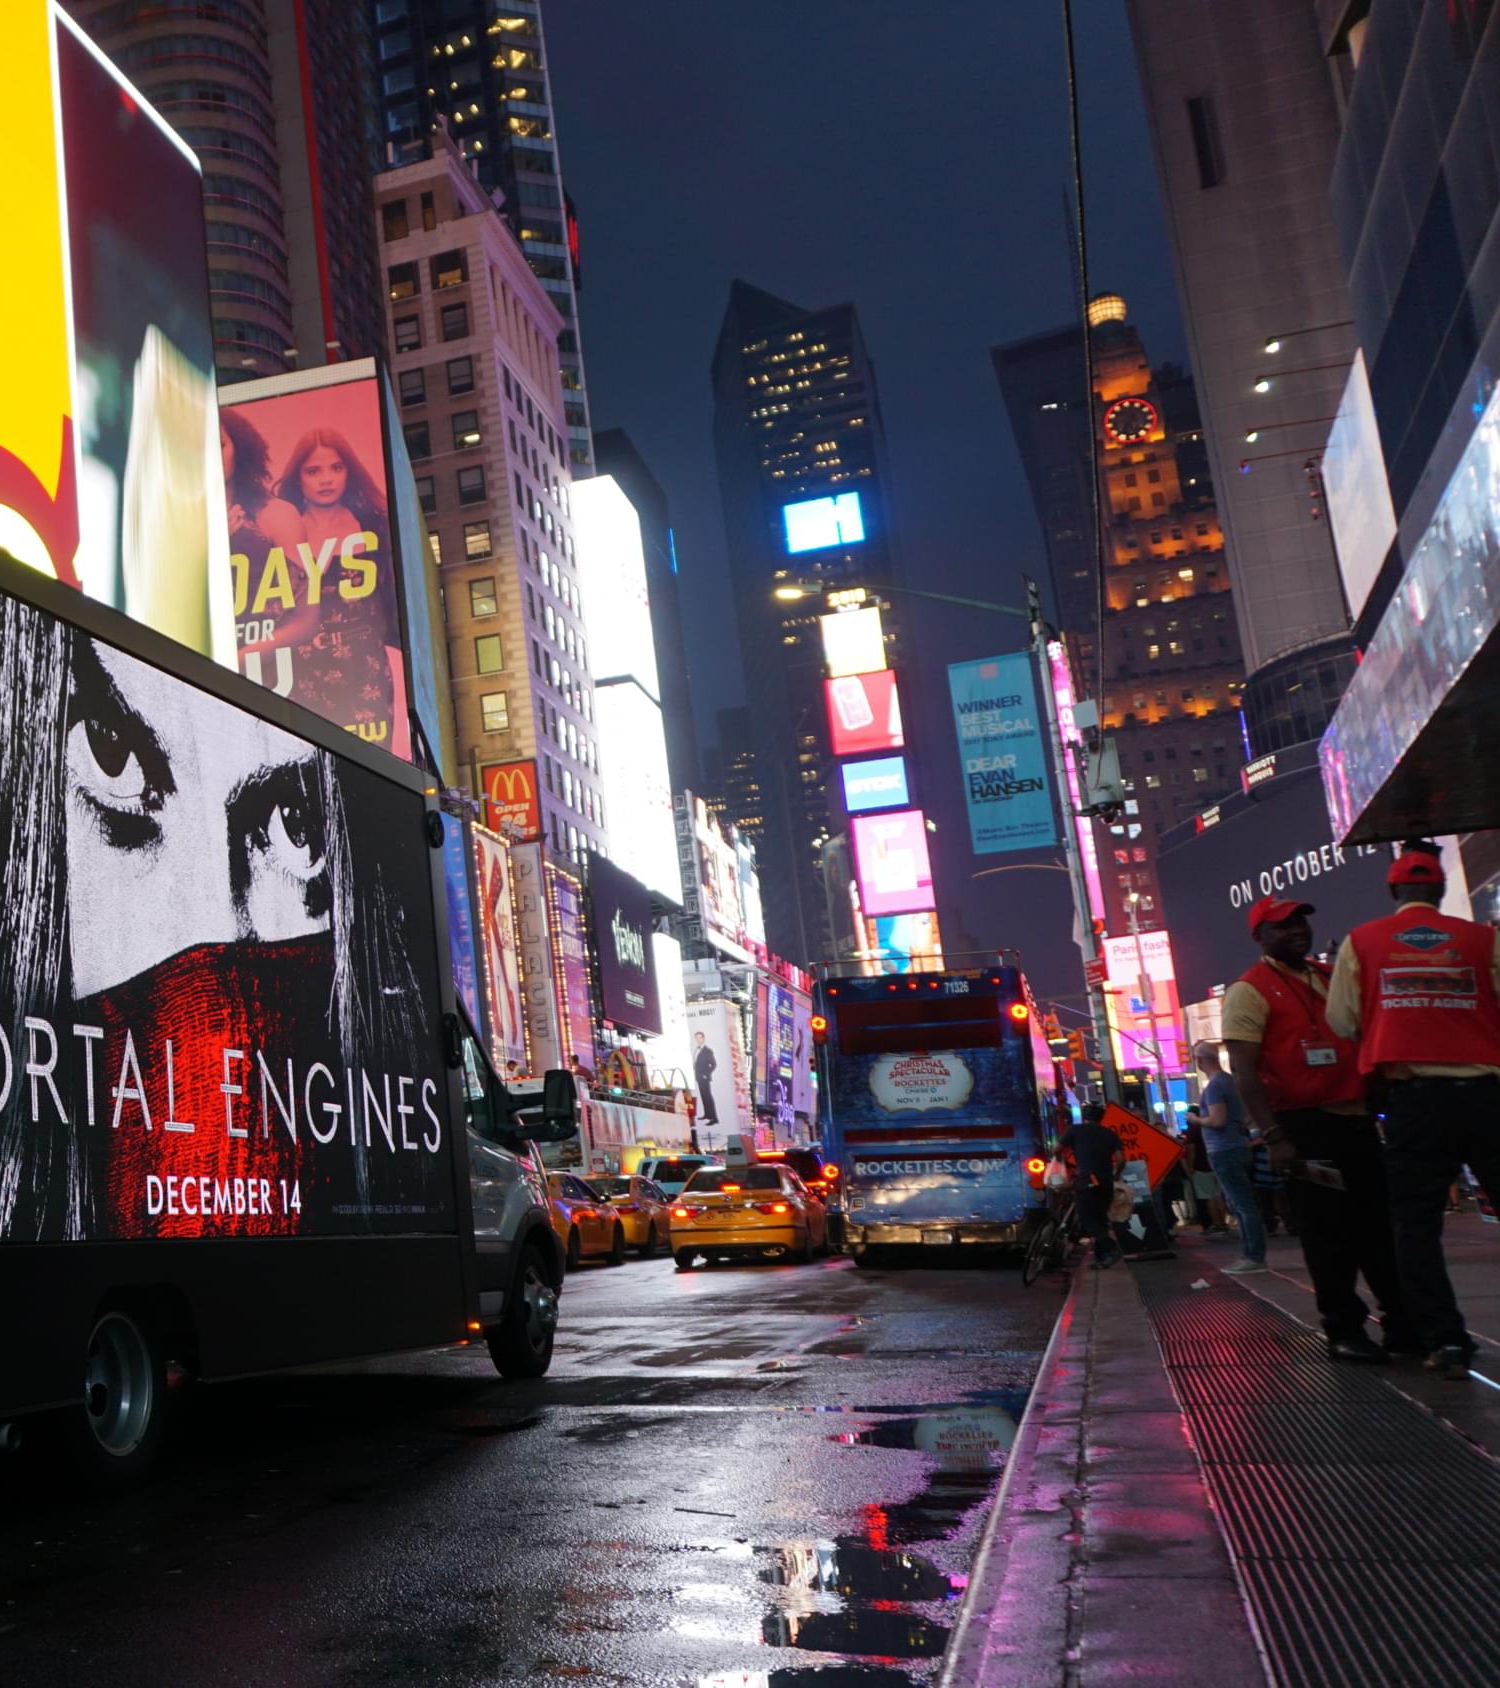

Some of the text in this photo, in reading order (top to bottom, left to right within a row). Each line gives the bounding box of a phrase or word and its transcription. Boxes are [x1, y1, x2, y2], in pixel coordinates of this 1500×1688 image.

[236, 619, 275, 645] FOR
[958, 694, 1022, 714] WINNER
[960, 710, 1001, 726] BEST
[962, 718, 1034, 738] MUSICAL
[966, 754, 1017, 773] DEAR
[968, 767, 1015, 786] EVAN
[970, 776, 1044, 799] HANSEN
[495, 802, 530, 814] OPEN
[1230, 880, 1253, 908] ON
[1259, 842, 1346, 895] OCTOBER
[515, 863, 551, 1040] PALACE
[1382, 998, 1476, 1009] TICKET AGENT
[888, 1068, 951, 1079] SPECTACULAR
[893, 1059, 945, 1070] CHRISTMAS
[895, 1078, 946, 1088] ROCKETTES
[219, 1047, 442, 1154] ENGINES
[855, 1158, 1000, 1176] ROCKETTES.COM
[146, 1174, 302, 1215] DECEMBER 14
